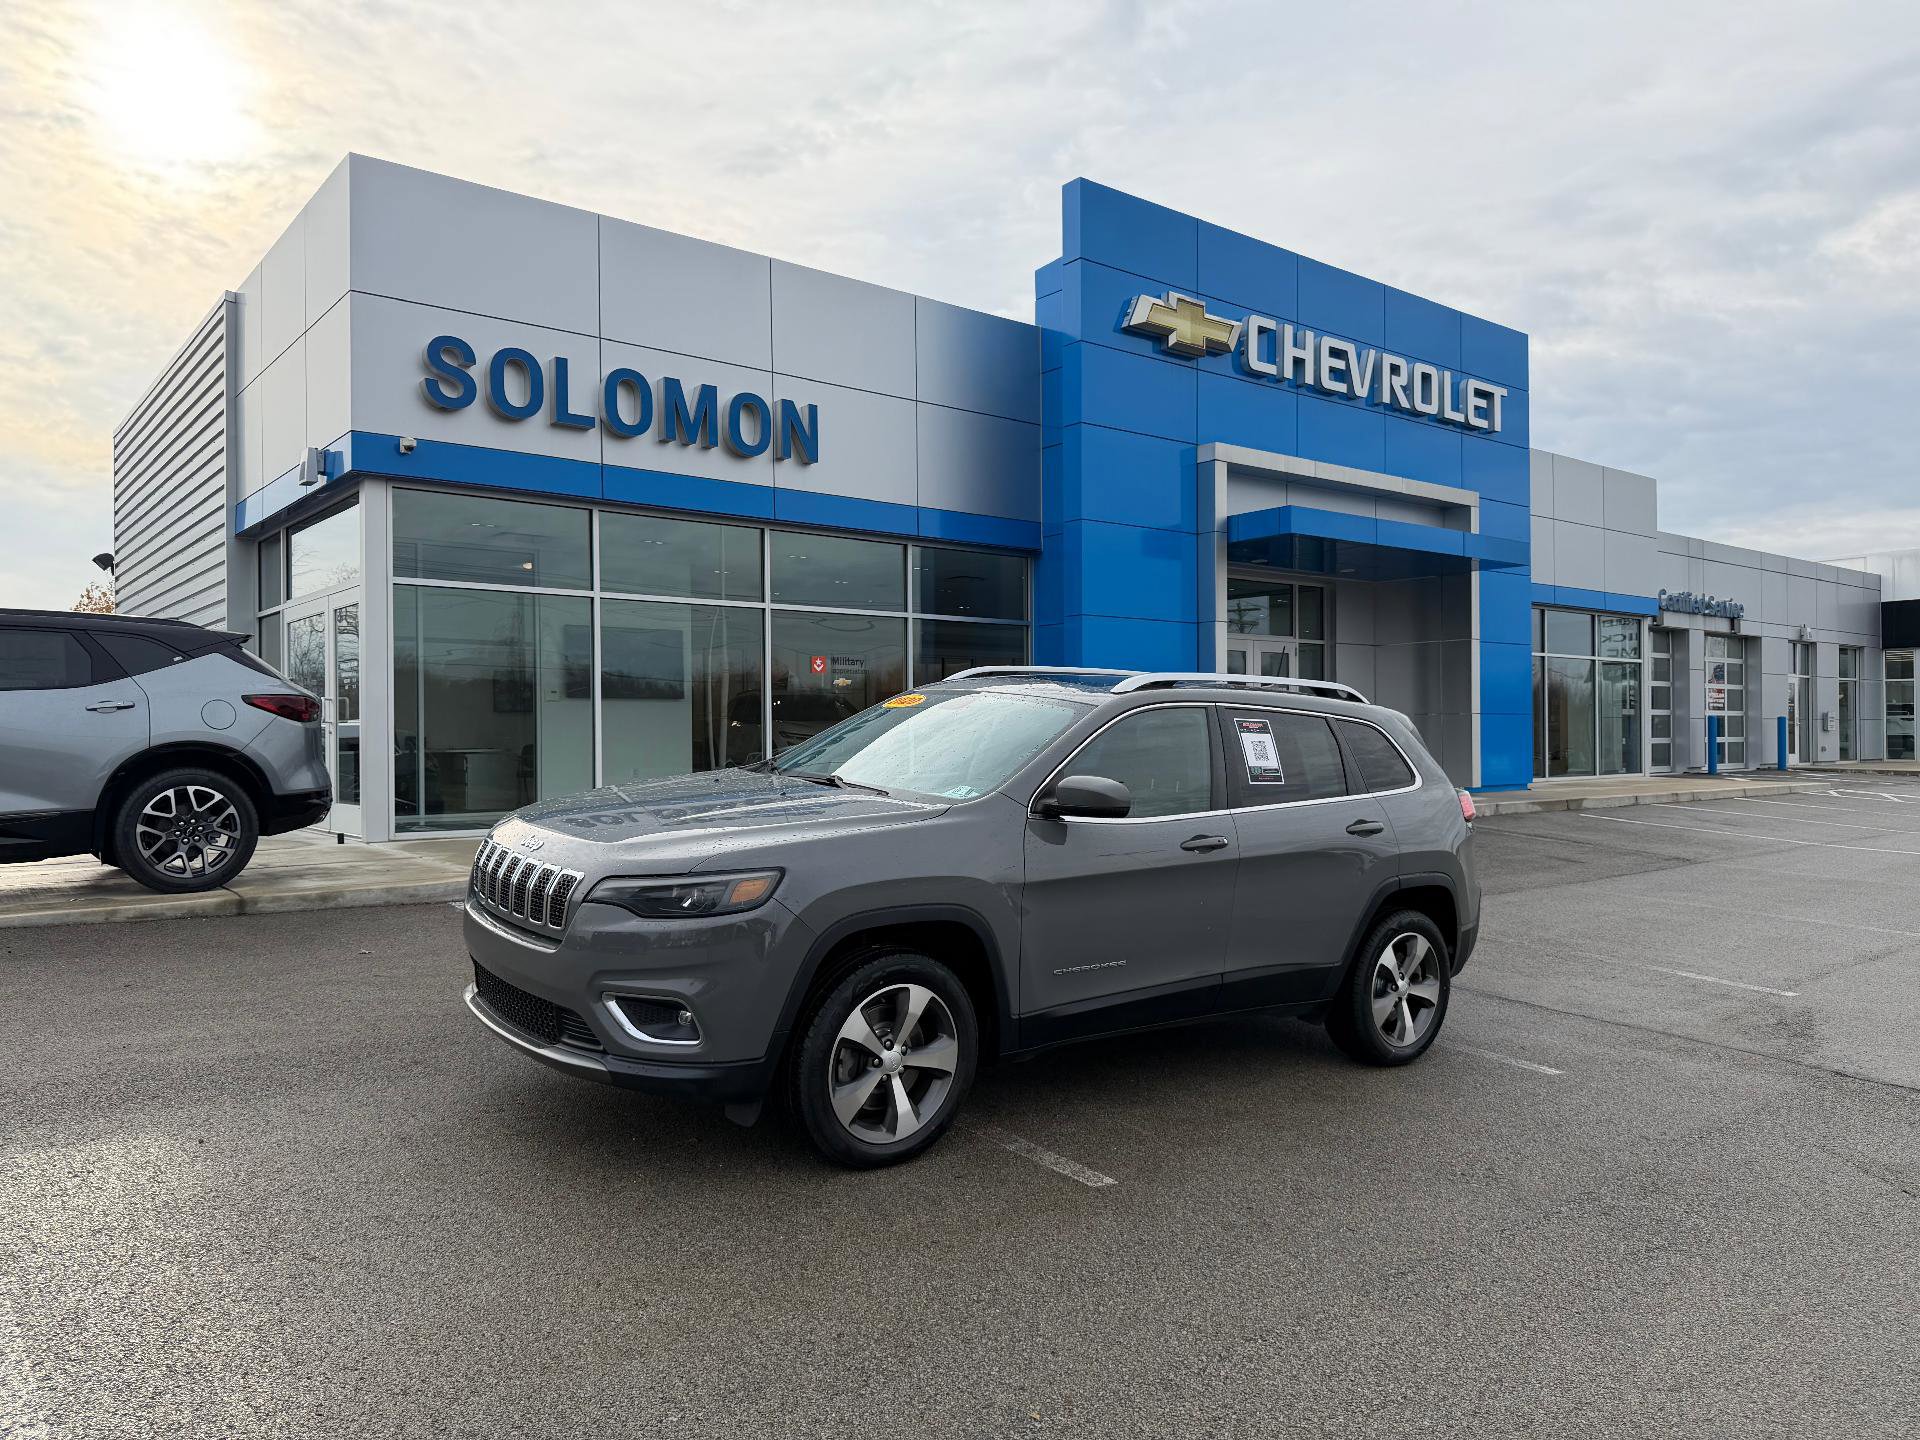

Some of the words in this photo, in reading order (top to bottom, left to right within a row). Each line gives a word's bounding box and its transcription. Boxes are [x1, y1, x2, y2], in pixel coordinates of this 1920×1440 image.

[1242, 314, 1508, 433] CHEVROLET
[420, 335, 819, 465] SOLOMON
[1658, 588, 1705, 614] Certified
[1705, 595, 1744, 618] Service
[832, 655, 865, 668] Military
[520, 834, 545, 852] Jeep
[1053, 960, 1127, 975] CHEROKEE
